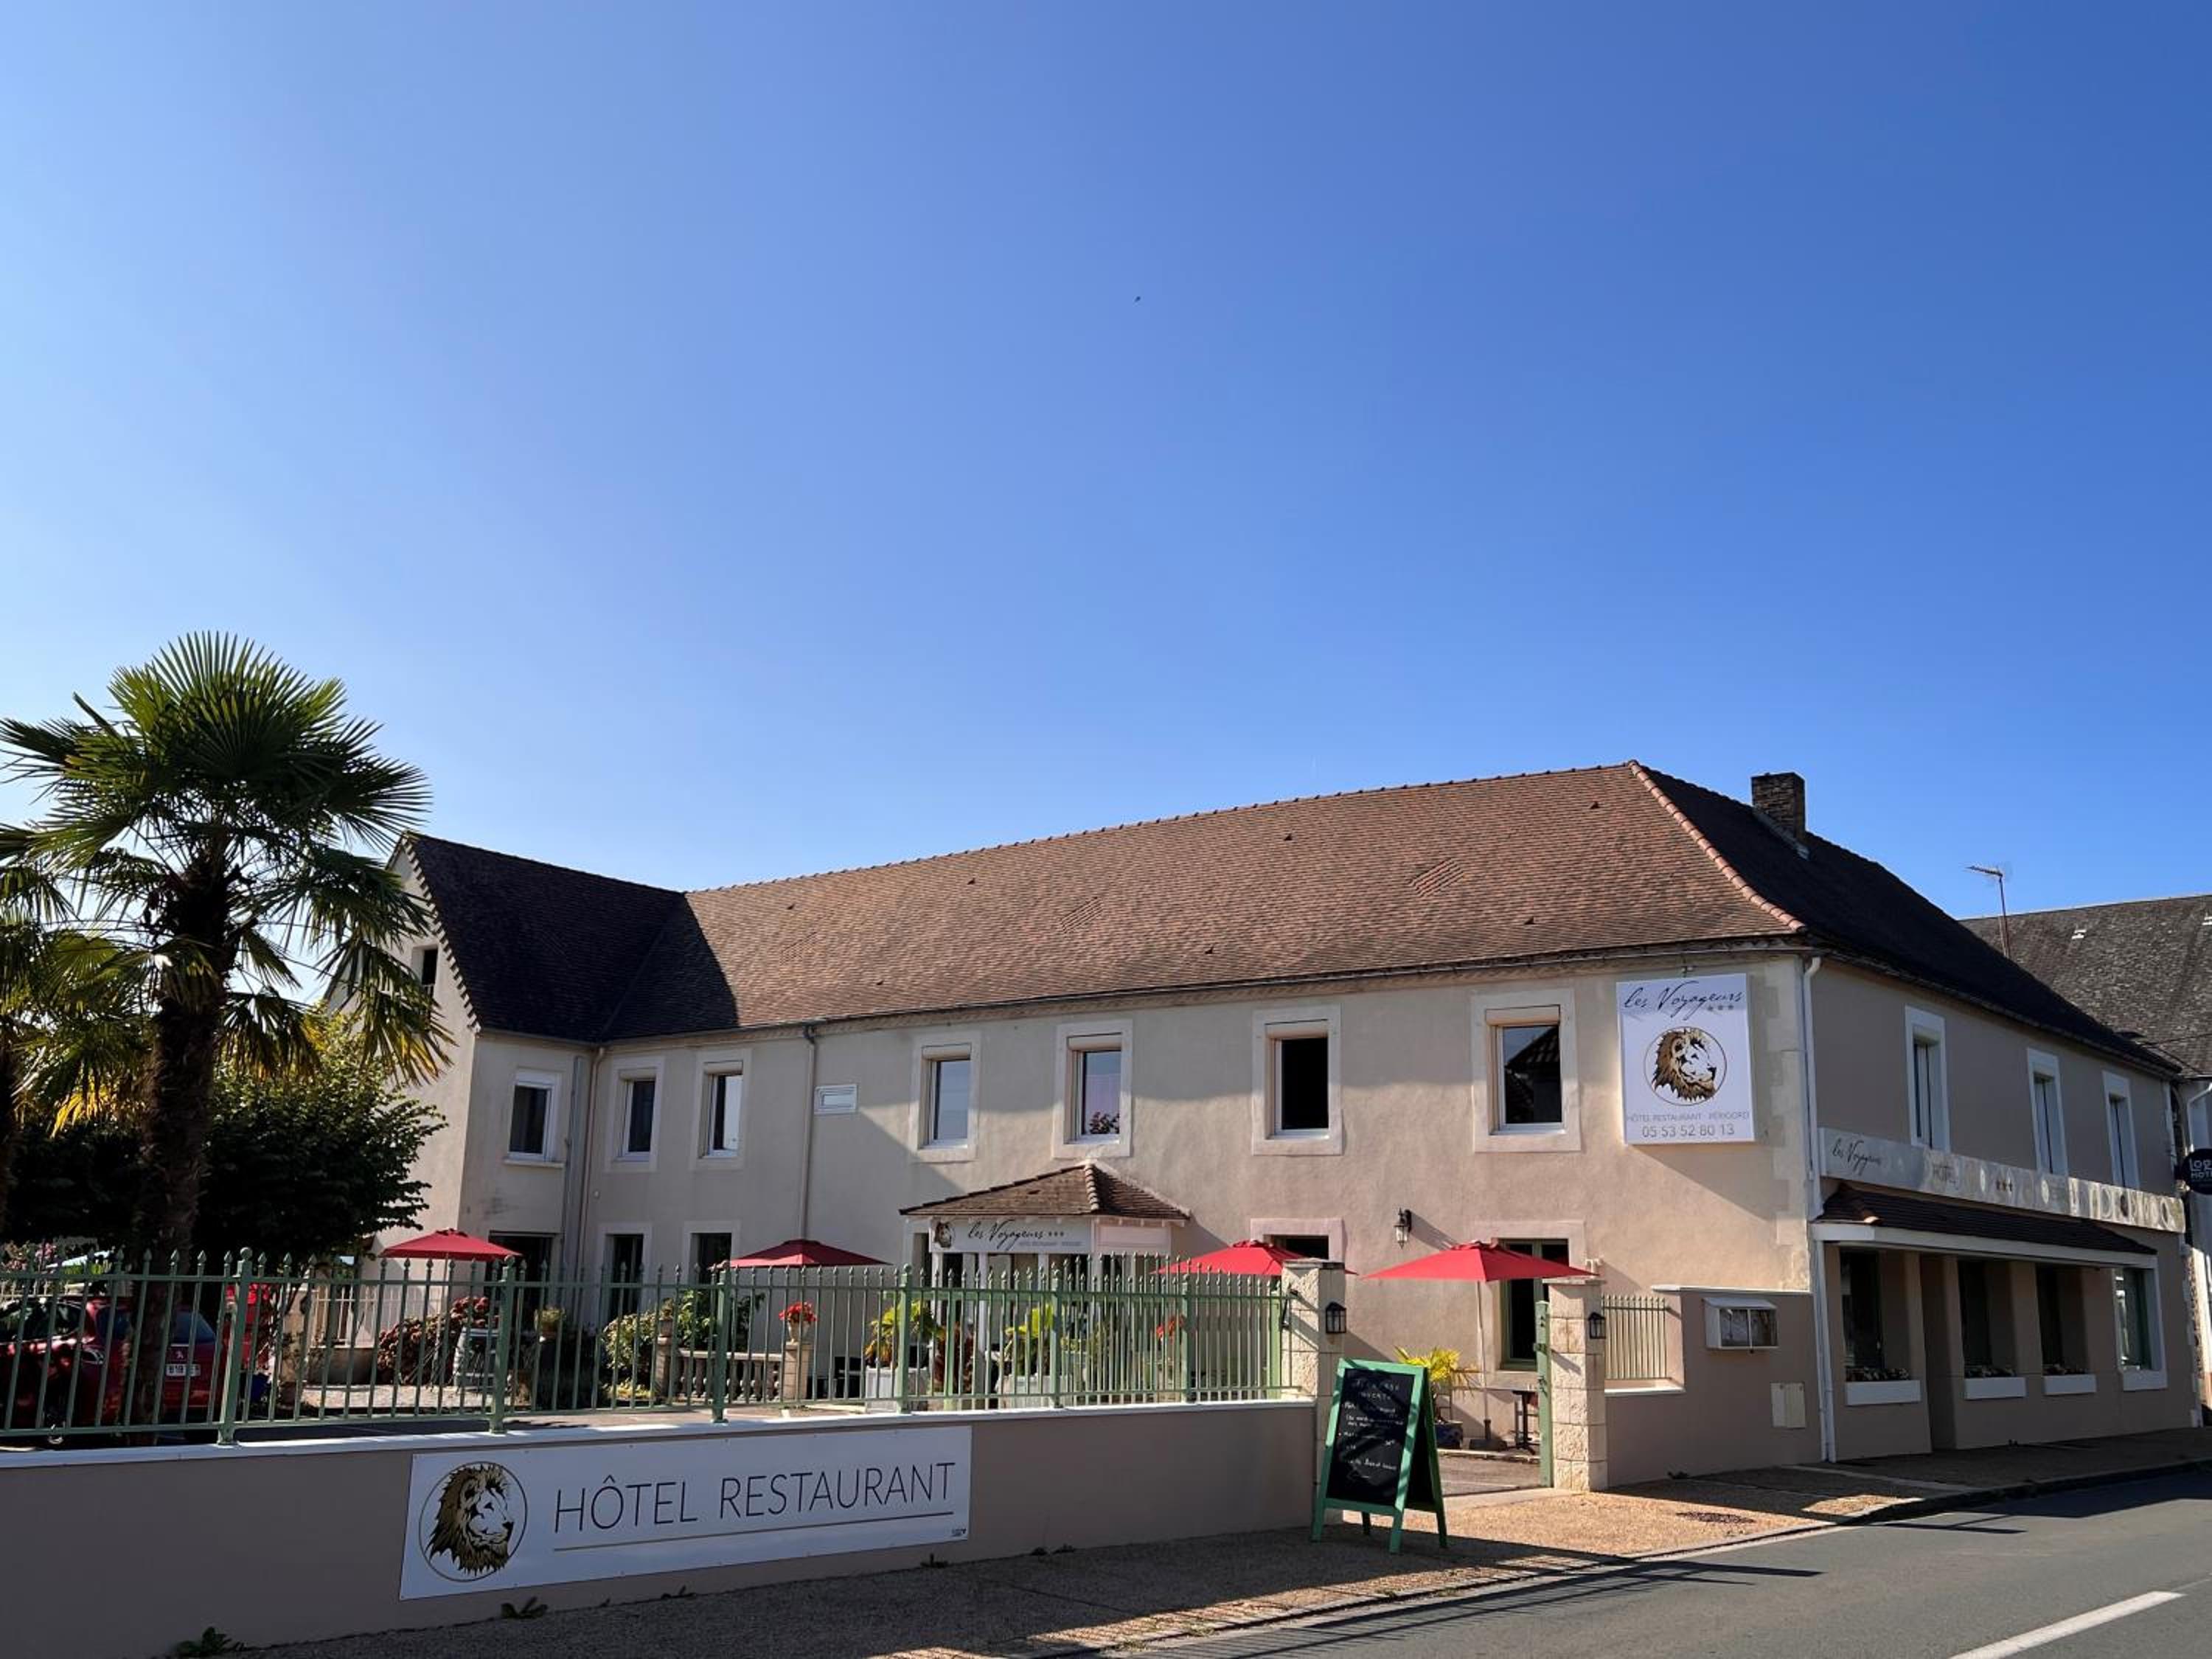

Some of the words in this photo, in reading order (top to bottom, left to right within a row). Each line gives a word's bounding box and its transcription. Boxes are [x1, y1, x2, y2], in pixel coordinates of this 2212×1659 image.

[1657, 980, 1743, 1020] Voyageurs
[1642, 1125, 1657, 1138] 05
[1661, 1125, 1676, 1137] 53
[1680, 1124, 1696, 1136] 52
[1700, 1124, 1715, 1136] 80
[1721, 1122, 1735, 1135] 13
[989, 1219, 1043, 1251] Voyageurs
[554, 1475, 698, 1534] HÔTEL
[720, 1462, 956, 1520] RESTAURANT
